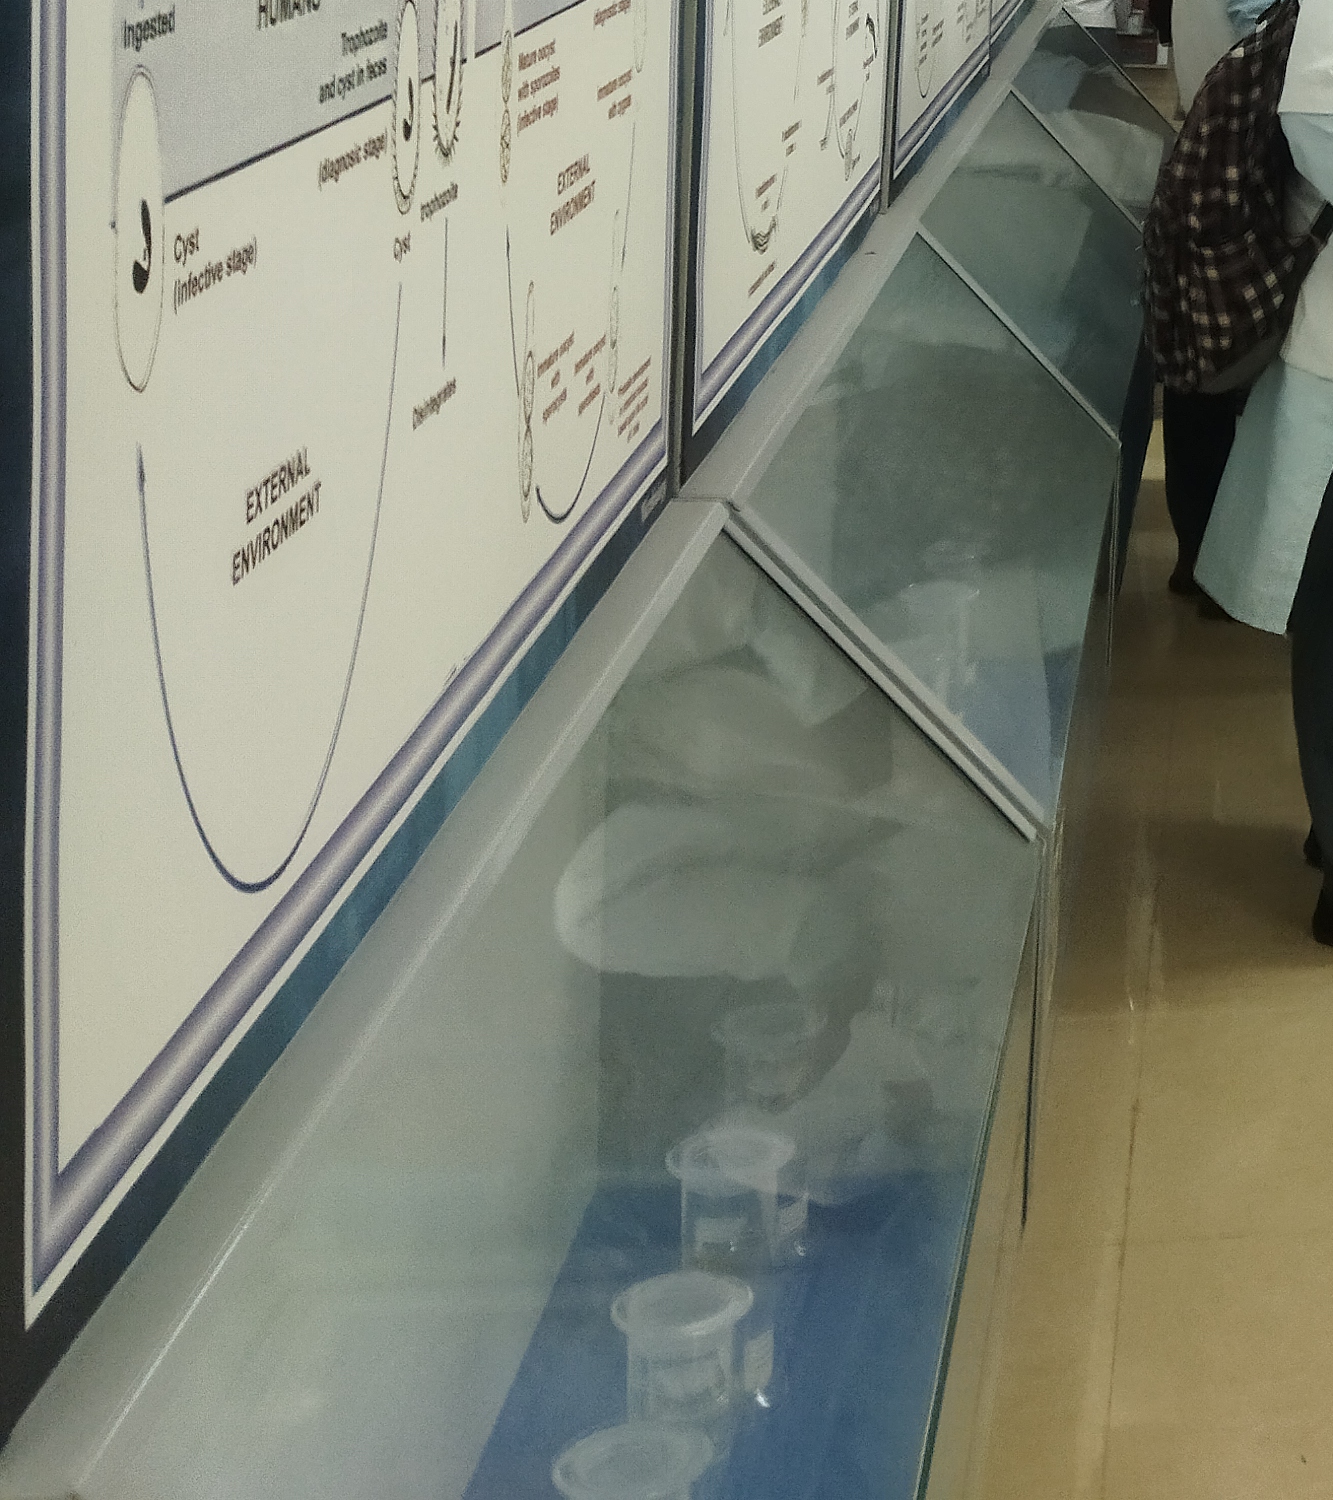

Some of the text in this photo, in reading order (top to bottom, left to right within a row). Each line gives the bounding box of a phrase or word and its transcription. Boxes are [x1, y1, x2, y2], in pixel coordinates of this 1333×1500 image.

[123, 3, 175, 51] Ingested
[319, 81, 336, 103] and
[338, 71, 354, 100] cyst
[174, 228, 199, 266] Cyst
[174, 235, 257, 315] (infective stage)
[246, 447, 310, 525] EXTERNAL
[232, 479, 322, 586] ENVIRONMENT
